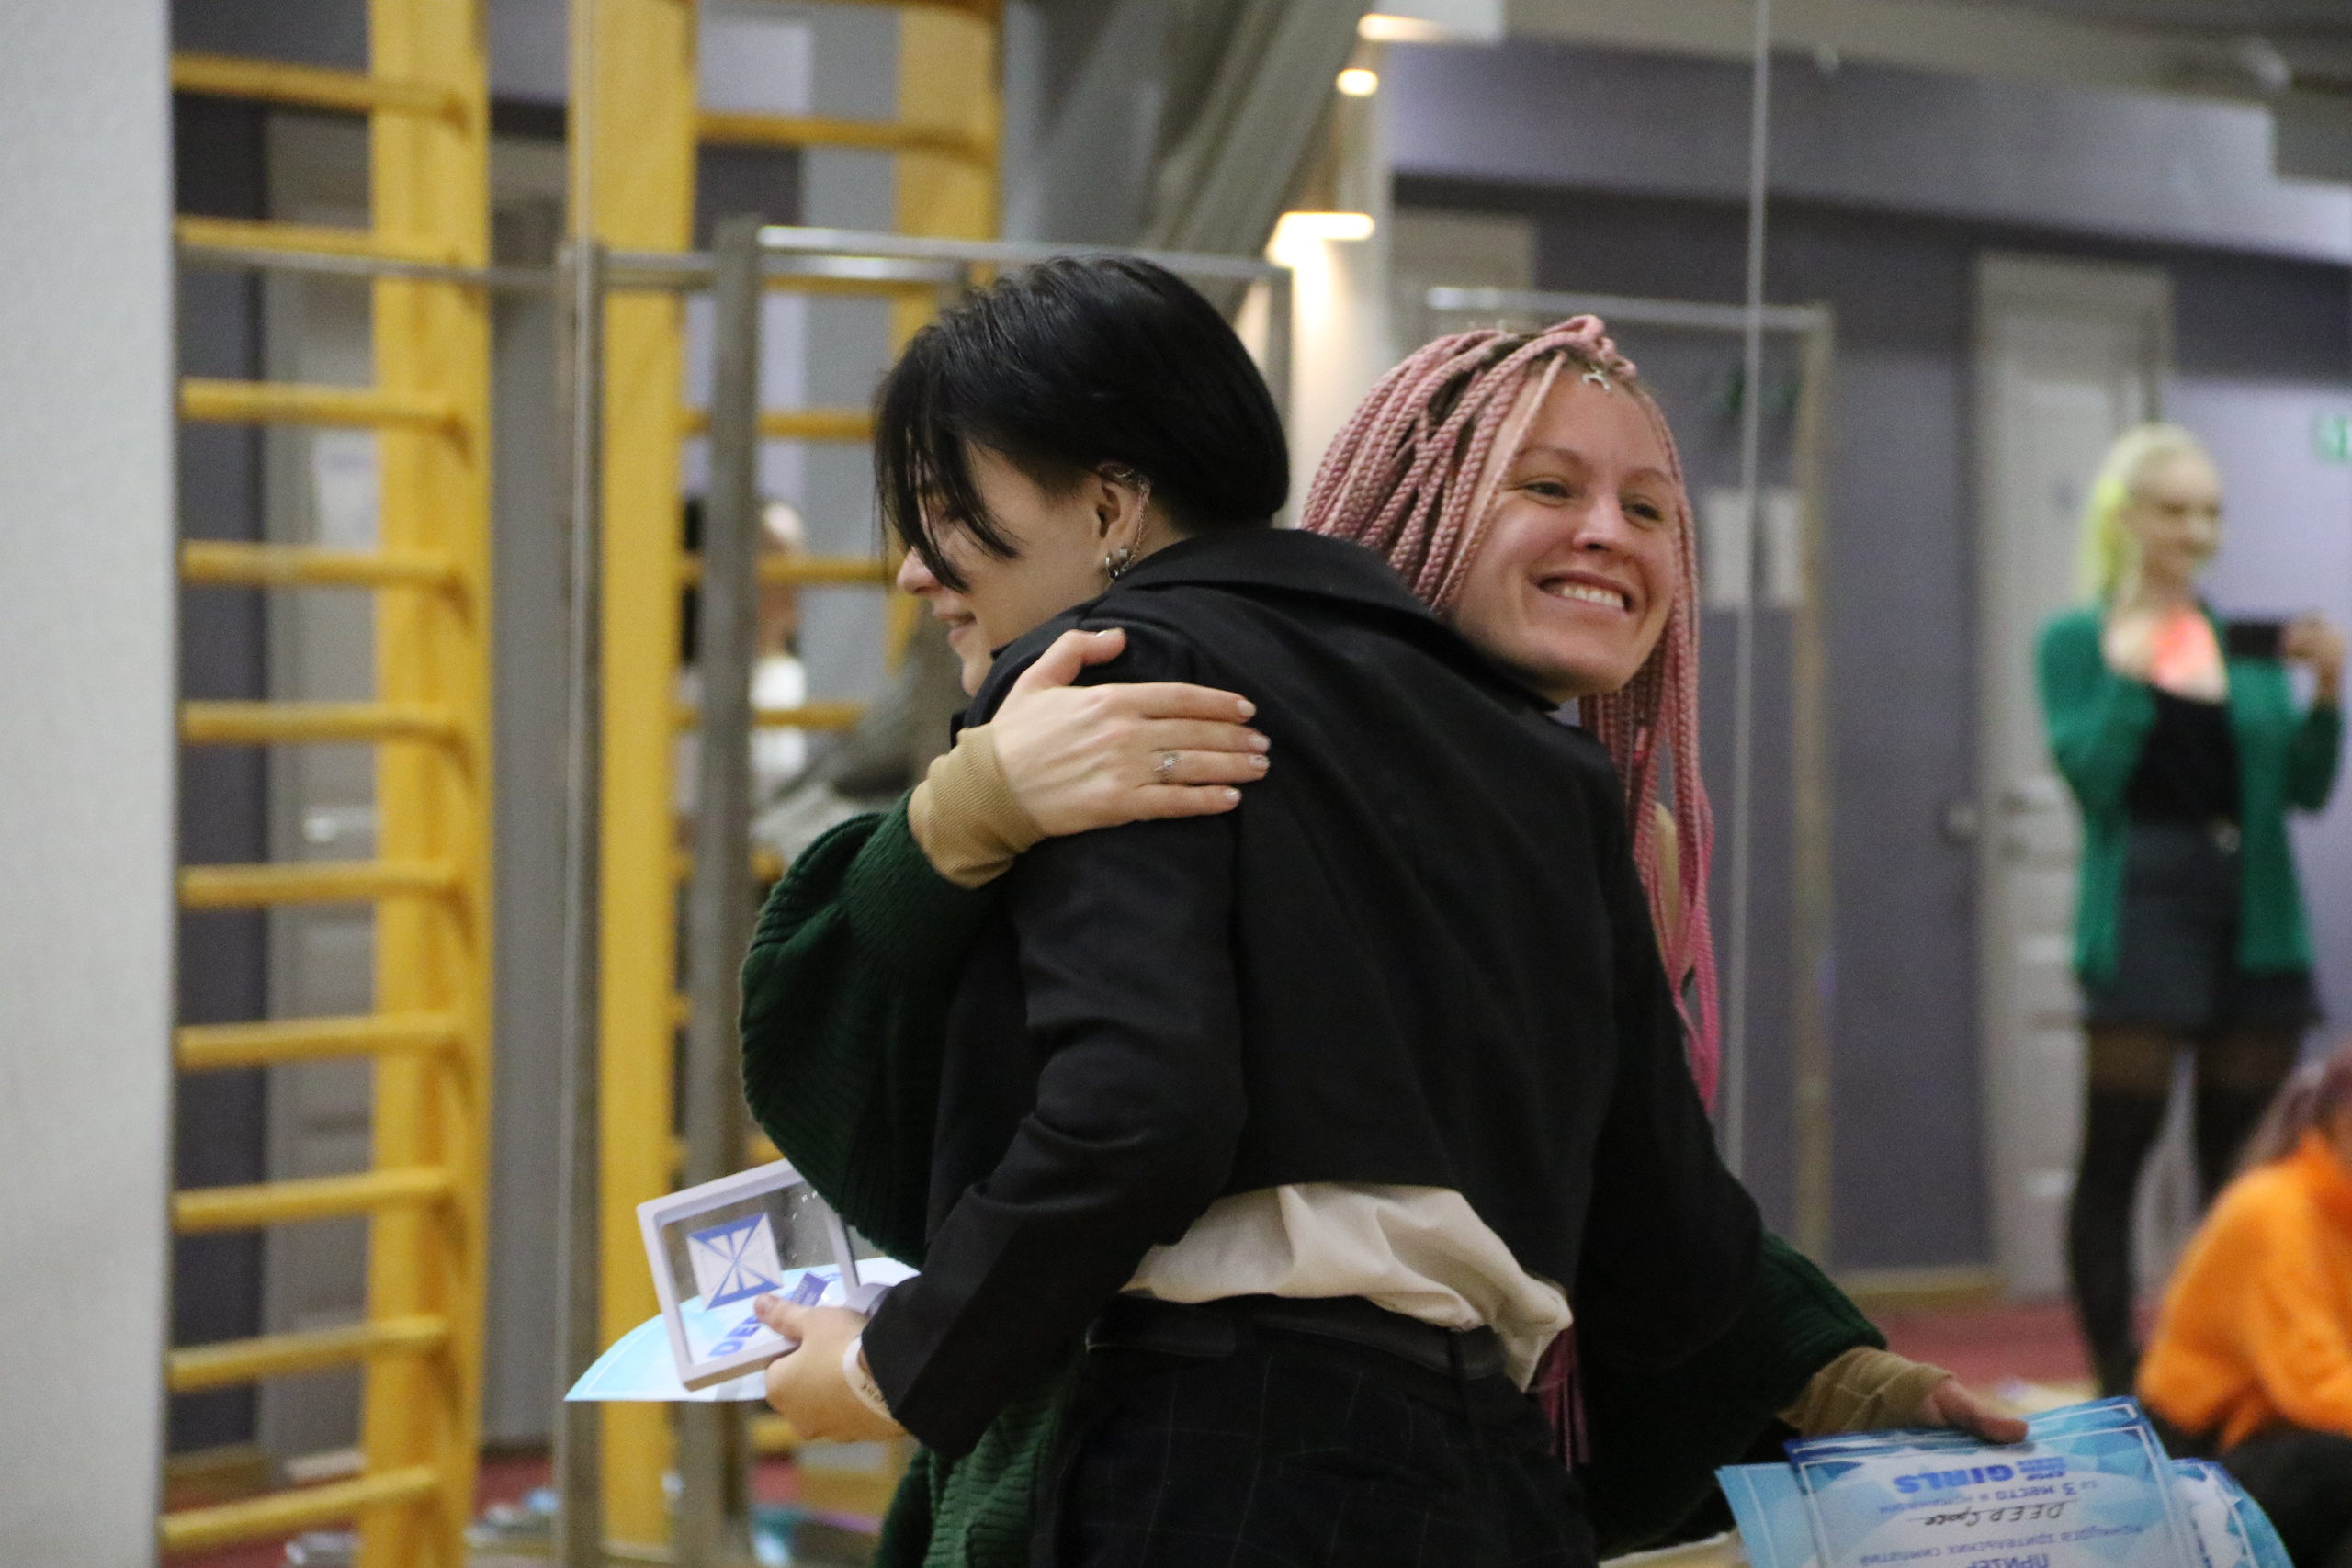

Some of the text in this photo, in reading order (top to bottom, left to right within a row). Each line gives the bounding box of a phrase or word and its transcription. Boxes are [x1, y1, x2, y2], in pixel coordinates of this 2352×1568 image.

[1894, 1464, 2014, 1493] GIRLS
[1995, 1485, 2055, 1501] место
[2062, 1482, 2076, 1495] 3
